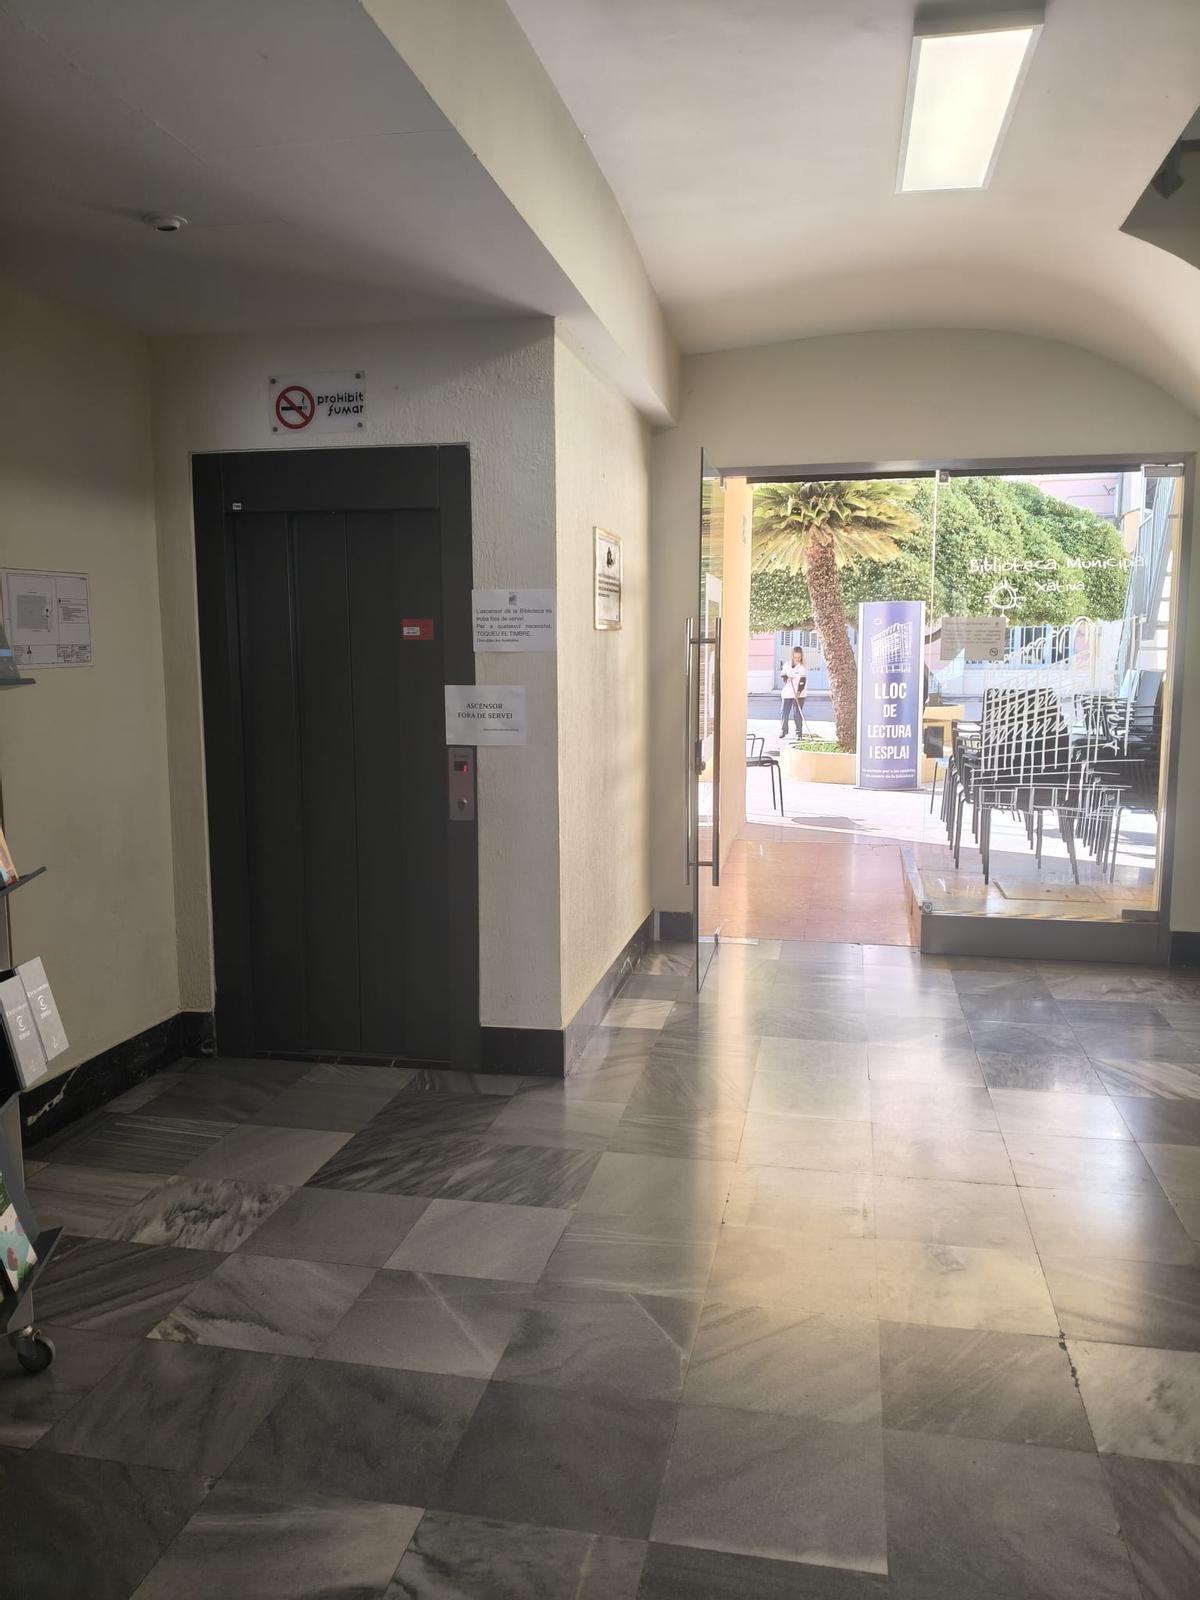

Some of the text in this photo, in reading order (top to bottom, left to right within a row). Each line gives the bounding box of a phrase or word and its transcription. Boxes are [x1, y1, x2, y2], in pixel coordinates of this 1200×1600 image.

[874, 682, 907, 700] LLOC
[883, 703, 897, 718] DE
[867, 724, 911, 739] LECTURA
[869, 745, 910, 760] I ESPLAI
